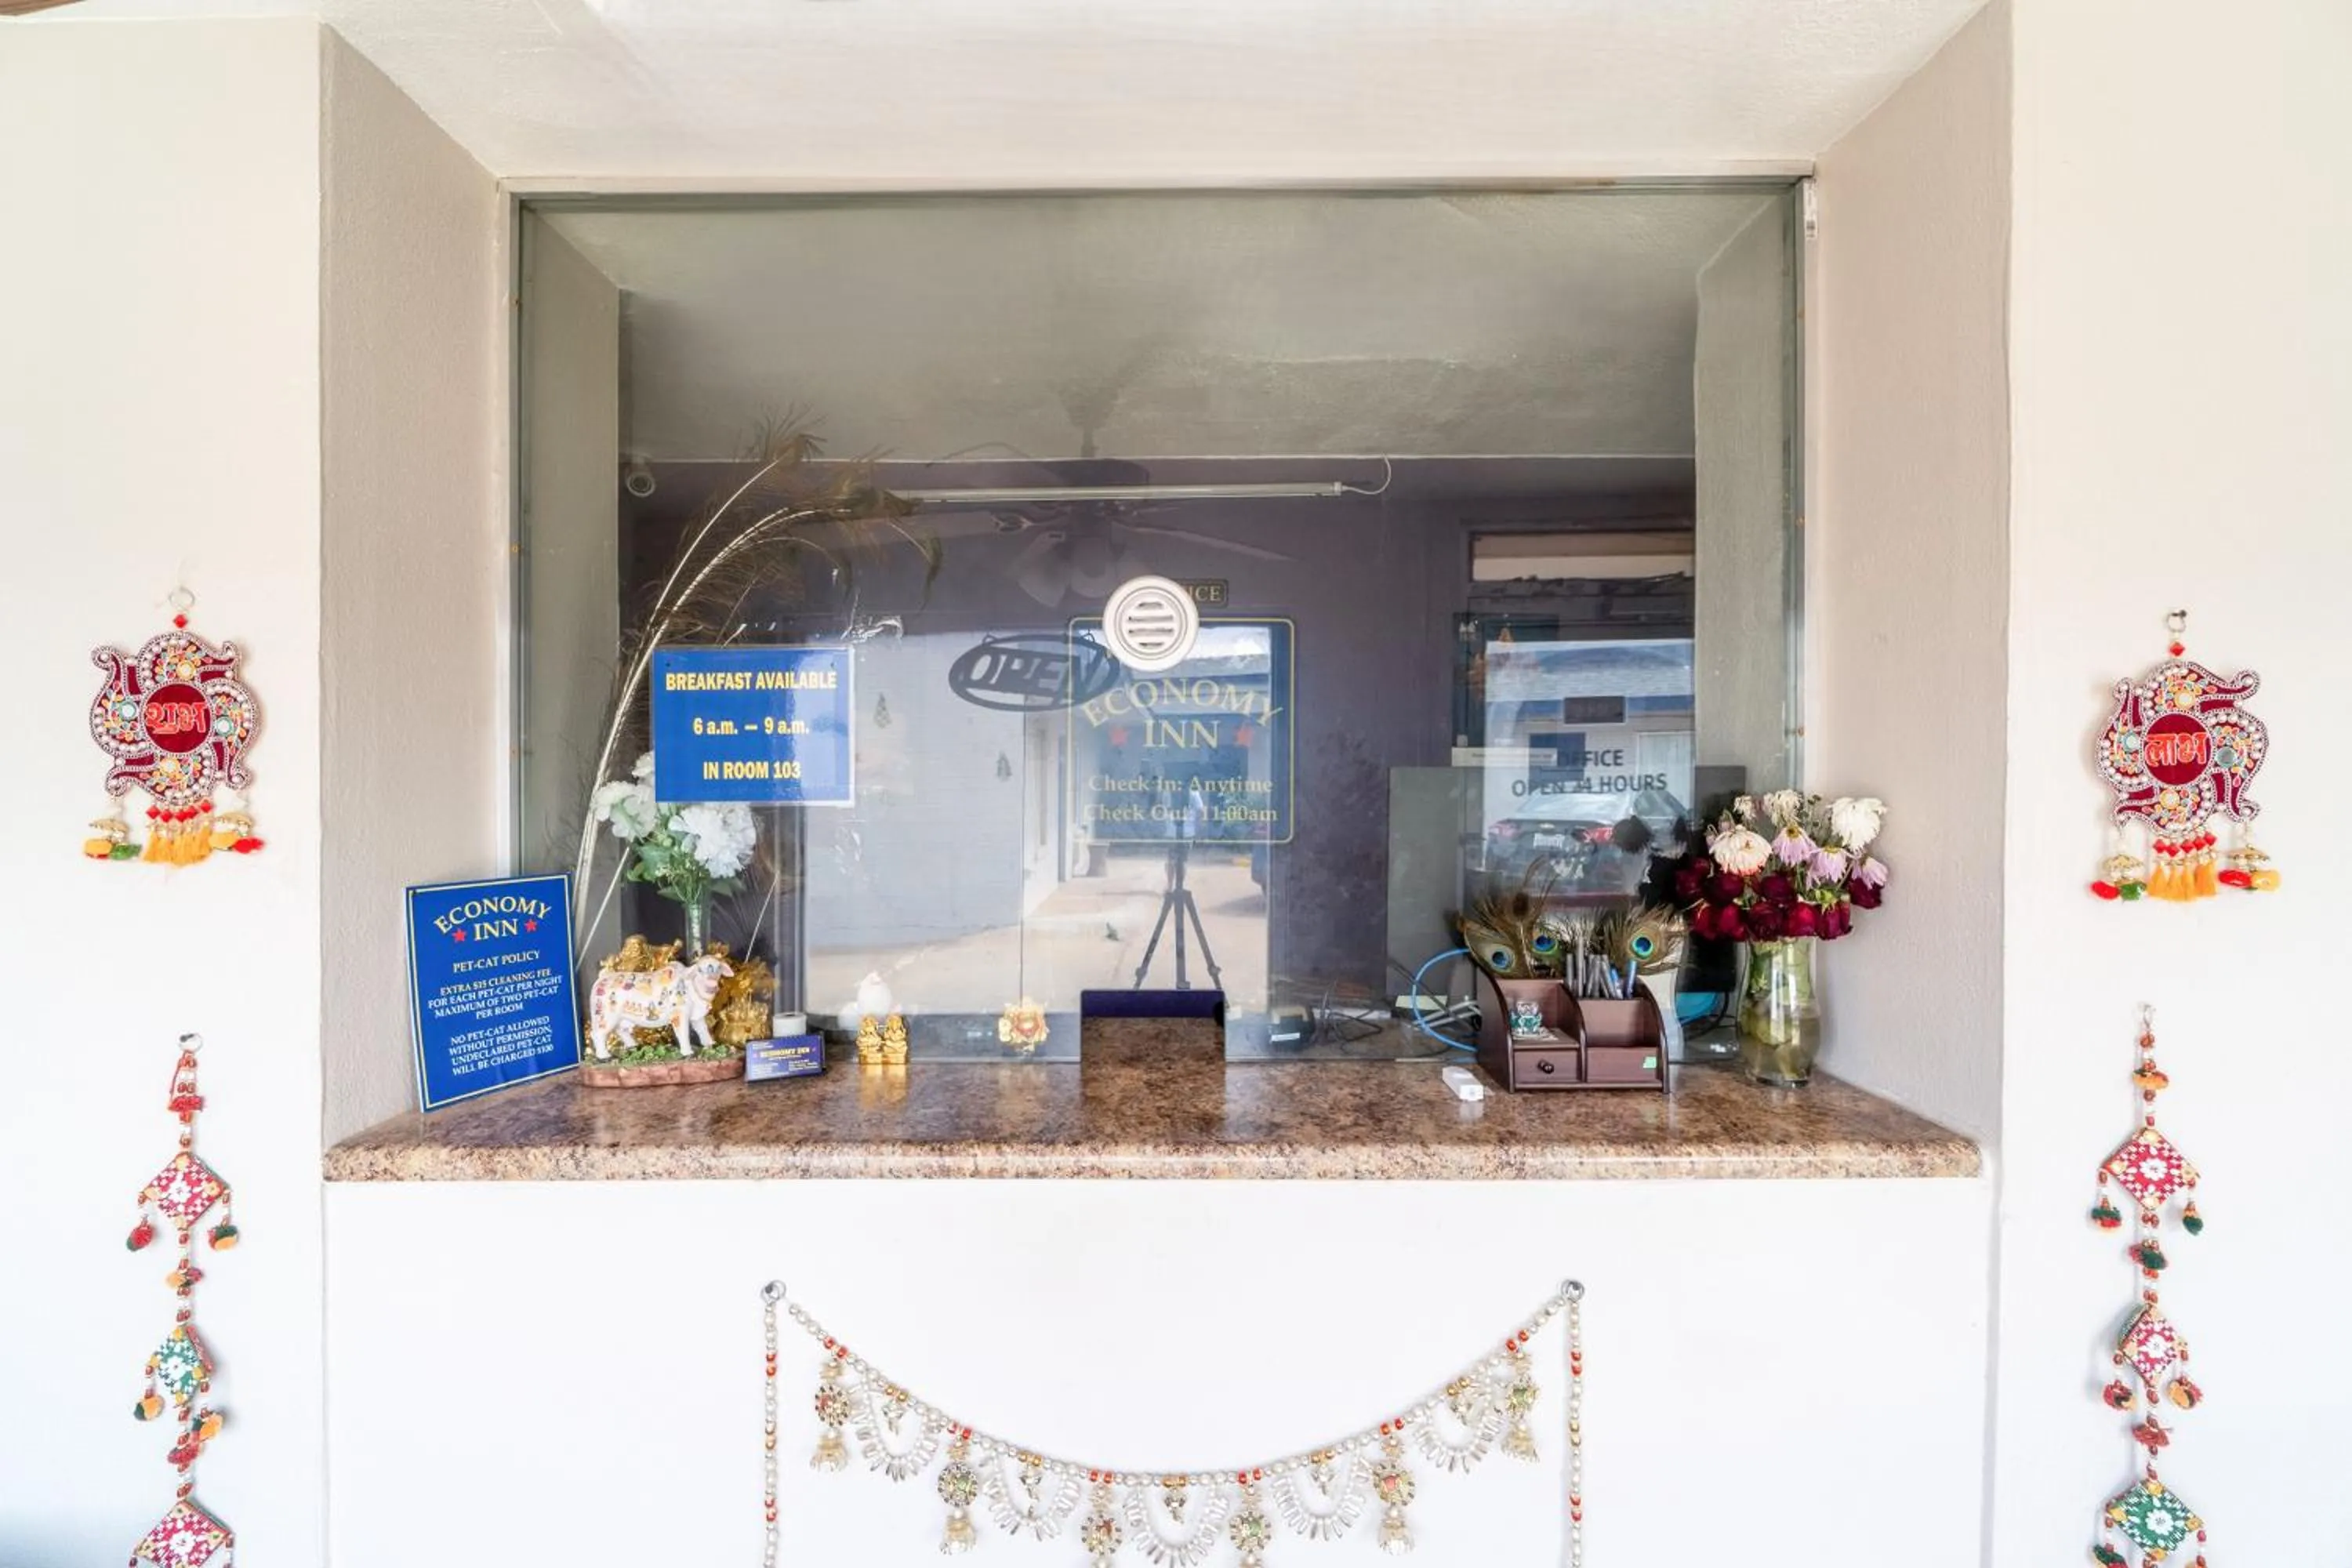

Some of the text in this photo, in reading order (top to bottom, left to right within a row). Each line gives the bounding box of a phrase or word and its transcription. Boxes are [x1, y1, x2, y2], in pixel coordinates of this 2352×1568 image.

[666, 671, 838, 691] BREAKFAST AVAILABLE
[958, 644, 1107, 700] OPEN
[1080, 677, 1284, 728] ECONOMY
[144, 701, 208, 735] शुभ
[693, 717, 702, 735] 6
[706, 720, 739, 735] a.m.
[764, 717, 774, 735] 9
[777, 720, 810, 735] a.m.
[1143, 720, 1221, 748] INN
[2144, 731, 2207, 768] लाभ
[703, 761, 801, 779] IN ROOM 103
[1600, 772, 1668, 793] HOURS
[1089, 775, 1149, 793] Check
[1189, 775, 1273, 797] Anytime
[1084, 804, 1145, 822] Check
[1202, 804, 1278, 822] 11:00am
[434, 895, 553, 935] ECONOMY
[474, 917, 518, 942] INN
[452, 949, 540, 973] PET-CAT POLICY
[428, 997, 448, 1010] FOR
[449, 990, 476, 1004] EACH
[517, 979, 533, 991] PER
[534, 975, 563, 988] NIGHT
[440, 982, 471, 996] EXTRA
[488, 971, 535, 988] CLEANING
[434, 1002, 485, 1018] MAXIMUM
[487, 997, 501, 1007] OF
[503, 992, 523, 1004] TWO
[476, 1003, 524, 1019] PER ROOM
[451, 1034, 466, 1046] NO
[506, 1015, 550, 1033] ALLOWED
[449, 1037, 494, 1056] WITHOUT
[452, 1044, 515, 1066] UNDECLARED
